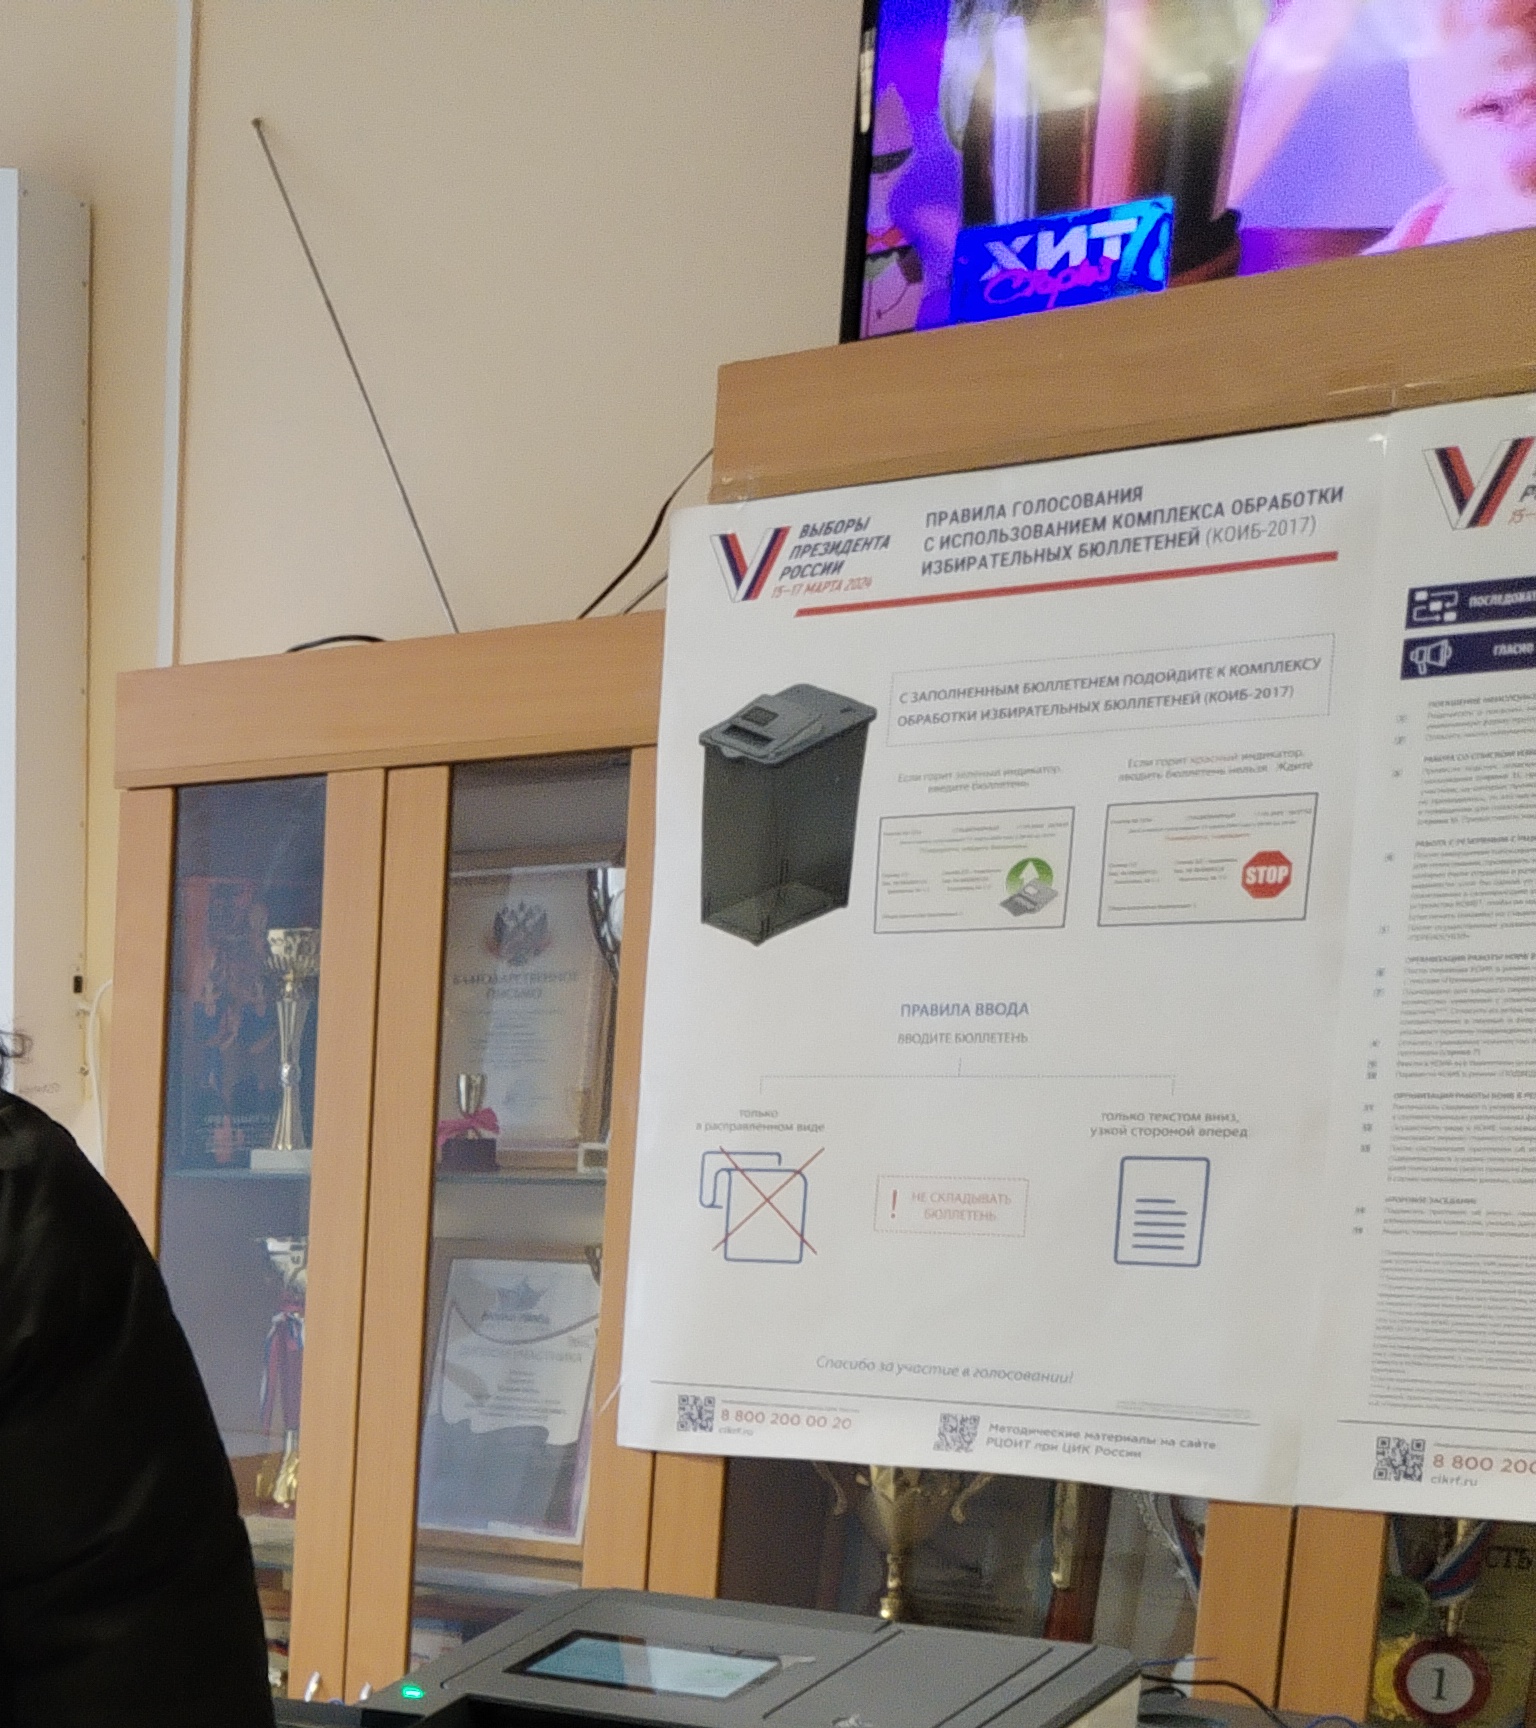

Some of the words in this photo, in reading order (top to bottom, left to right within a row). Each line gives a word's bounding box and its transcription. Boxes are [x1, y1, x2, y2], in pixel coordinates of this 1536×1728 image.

[980, 217, 1139, 283] ХИТ
[925, 505, 1007, 528] ПРАВИЛА
[1012, 486, 1144, 519] ГОЛОСОВАНИЯ
[799, 516, 871, 539] ВЫБОРЫ
[924, 534, 935, 553] С
[940, 511, 1107, 551] ИСПОЛЬЗОВАНИЕМ
[1112, 501, 1225, 530] КОМПЛЕКСА
[1231, 486, 1345, 517] ОБРАБОТКИ
[789, 535, 891, 560] ПРЕЗИДЕНТА
[921, 544, 1073, 578] ИЗБИРАТЕЛЬНЫХ
[1078, 526, 1201, 561] БЮЛЛЕТЕНЕЙ
[1205, 513, 1318, 550] (КОИБ-2017)
[779, 560, 845, 581] РОССИИ
[805, 580, 842, 595] МАРТА
[844, 577, 873, 592] 2024
[899, 692, 909, 704] С
[911, 683, 1019, 704] ЗАПОЛНЕННЫМ
[1022, 675, 1120, 695] БЮЛЛЕТЕНЕМ
[1123, 665, 1214, 688] ПОДОЙДИТЕ
[1216, 664, 1227, 679] К
[1229, 656, 1322, 678] КОМПЛЕКСУ
[897, 709, 977, 728] ОБРАБОТКИ
[980, 700, 1100, 723] ИЗБИРАТЕЛЬНЫХ
[1104, 689, 1200, 712] БЮЛЛЕТЕНЕЙ
[1204, 685, 1294, 707] (КОИБ-2017)
[1245, 866, 1290, 885] STOP
[900, 1002, 971, 1017] ПРАВИЛА
[975, 1002, 1029, 1018] ВВОДА
[897, 1032, 951, 1045] ВВОДИТЕ
[954, 1032, 1028, 1044] БЮЛЛЕТЕНЬ
[912, 1192, 927, 1203] НЕ
[929, 1192, 1013, 1206] СКЛАДЫВАТЬ
[924, 1208, 997, 1222] БЮЛЛЕТЕНЬ
[815, 1355, 875, 1372] Спасибо
[878, 1361, 894, 1375] за
[895, 1363, 960, 1380] участие
[973, 1369, 1073, 1384] голосовании!
[720, 1409, 730, 1423] 8
[734, 1410, 767, 1425] 800
[770, 1413, 802, 1428] 200
[805, 1415, 829, 1430] 00
[831, 1417, 853, 1432] 20
[989, 1422, 1081, 1438] Методические
[1085, 1430, 1157, 1445] материалы
[1179, 1435, 1218, 1451] сайте
[1062, 1442, 1091, 1457] ЦИК
[1095, 1445, 1143, 1459] России
[1432, 1453, 1445, 1469] 8
[1451, 1454, 1494, 1472] 800
[1430, 1474, 1478, 1488] cikrf.ru
[1431, 1666, 1448, 1702] 1
